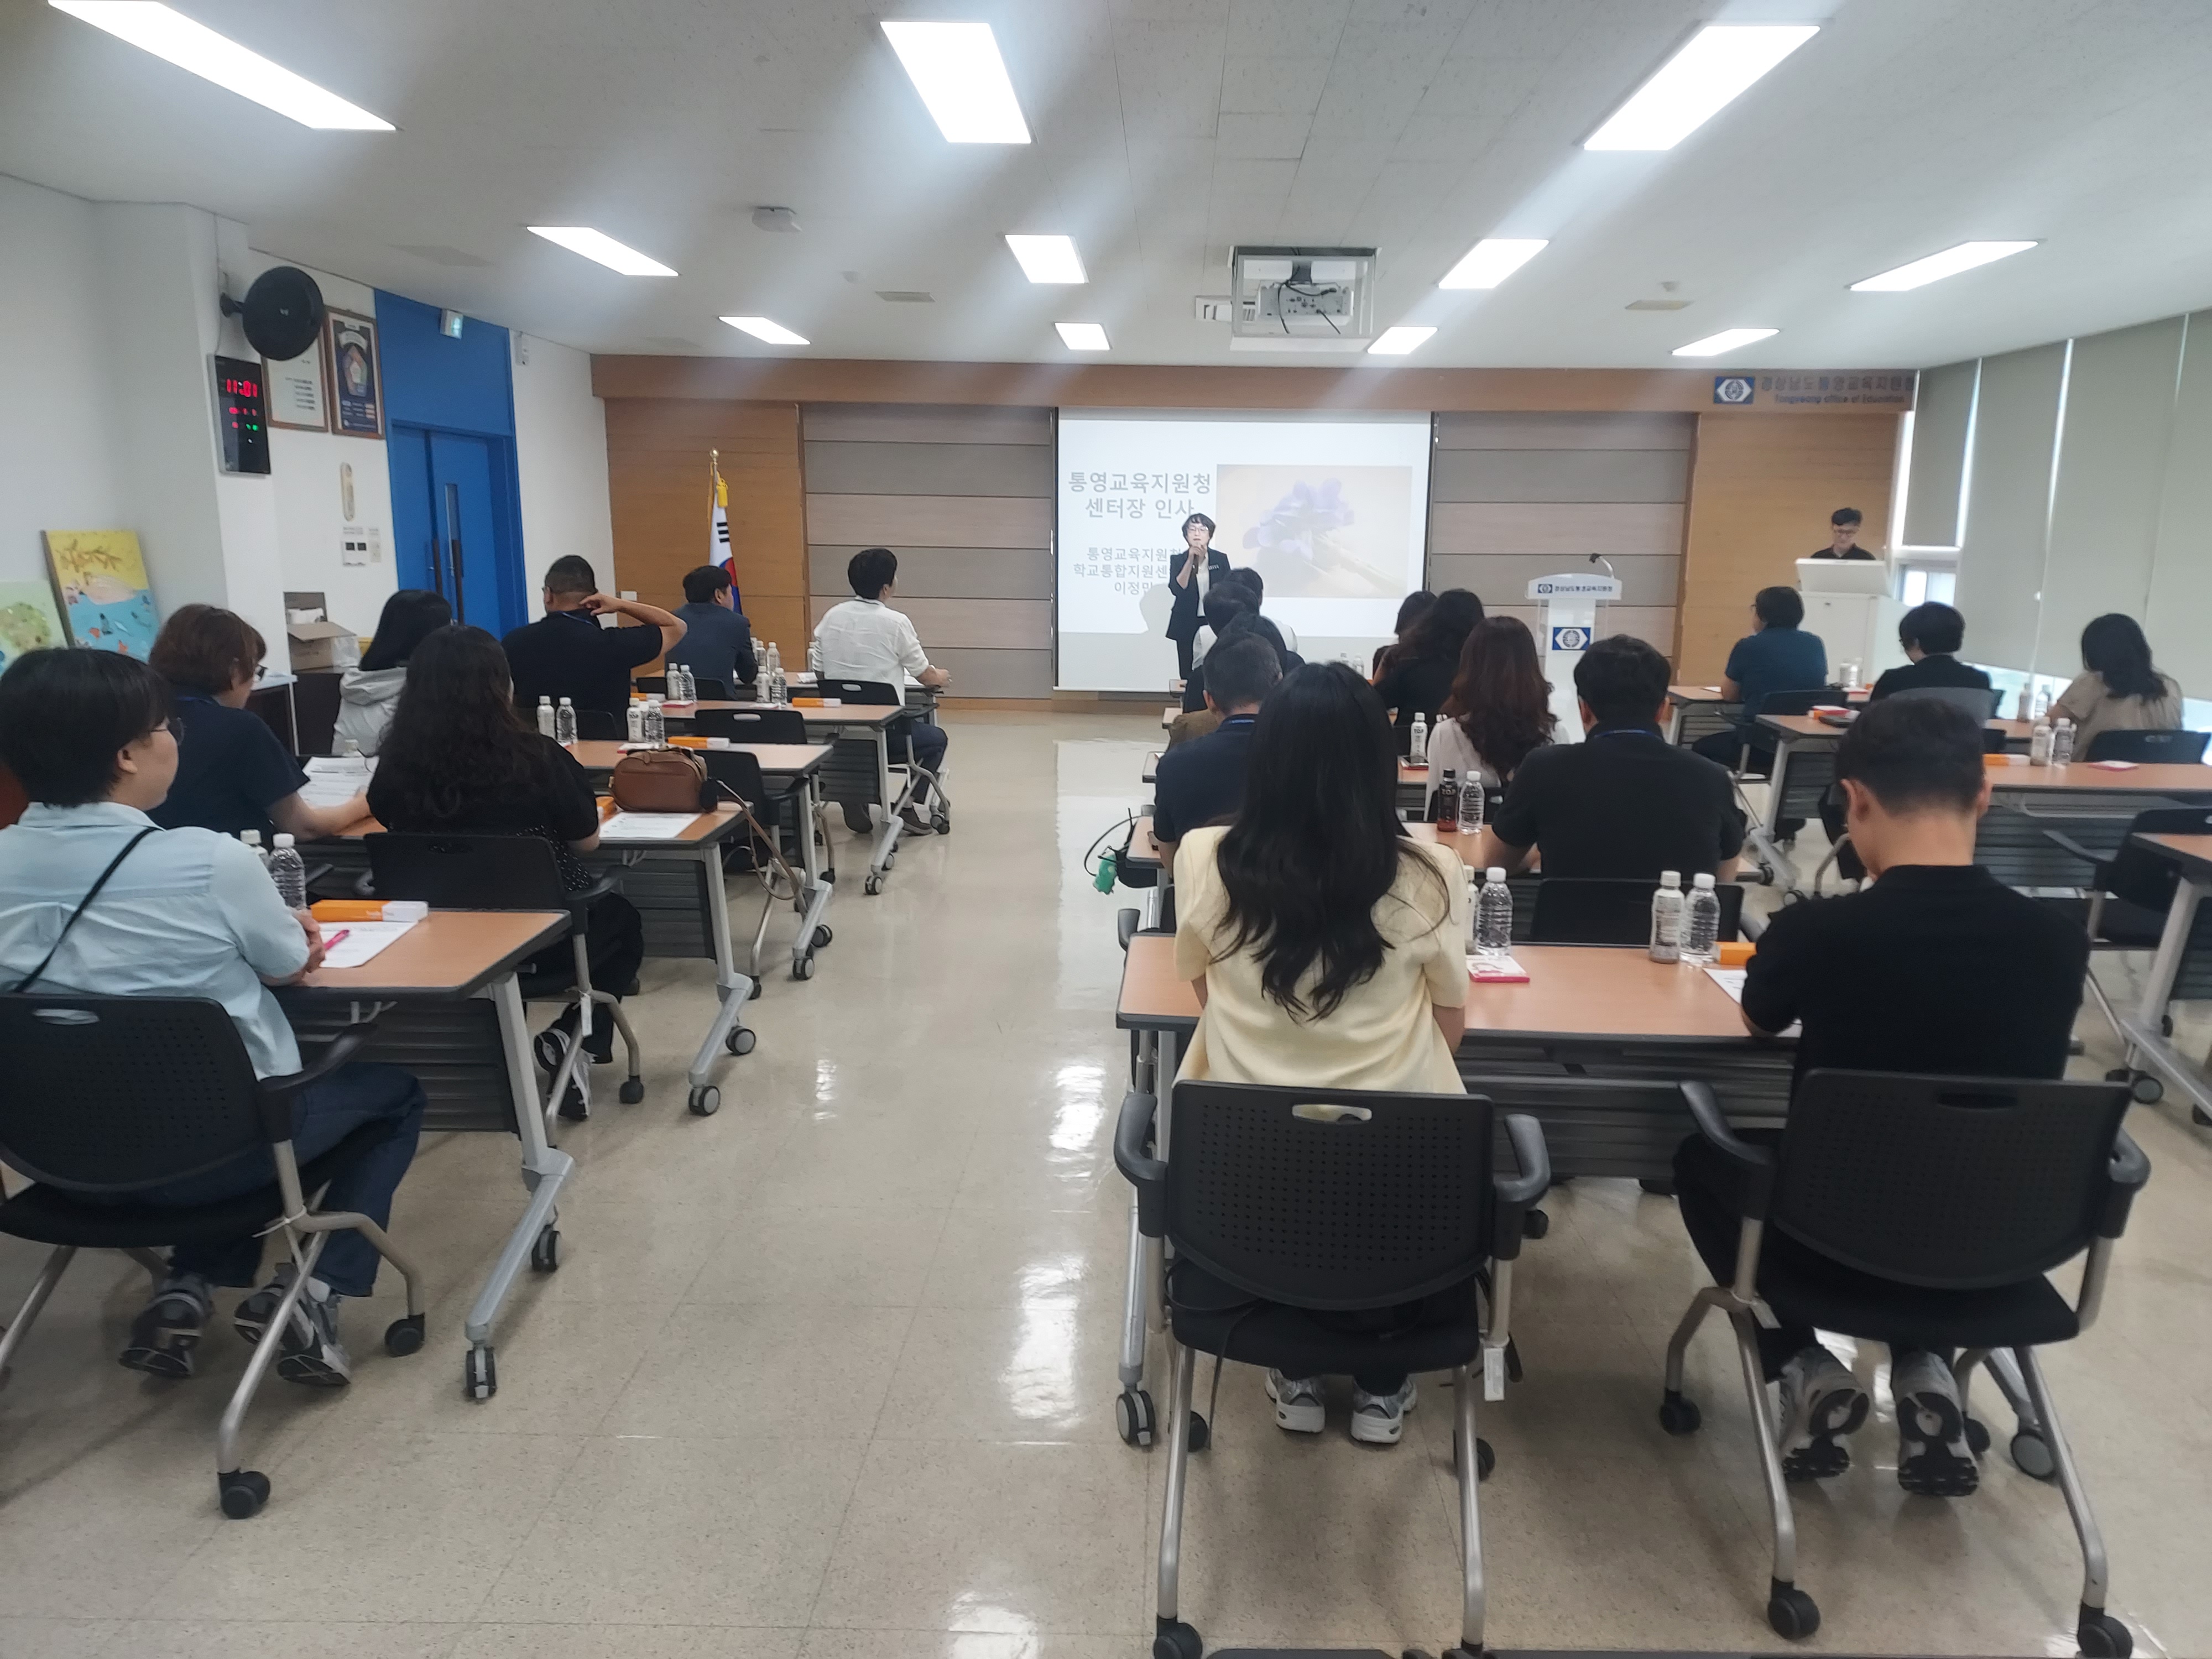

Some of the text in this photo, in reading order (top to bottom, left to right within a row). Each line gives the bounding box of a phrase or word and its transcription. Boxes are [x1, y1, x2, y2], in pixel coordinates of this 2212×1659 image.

[1068, 472, 1211, 494] 통영교육지원청
[1085, 498, 1194, 519] 센터장 인사
[1073, 563, 1169, 579] 학교통합지원센
